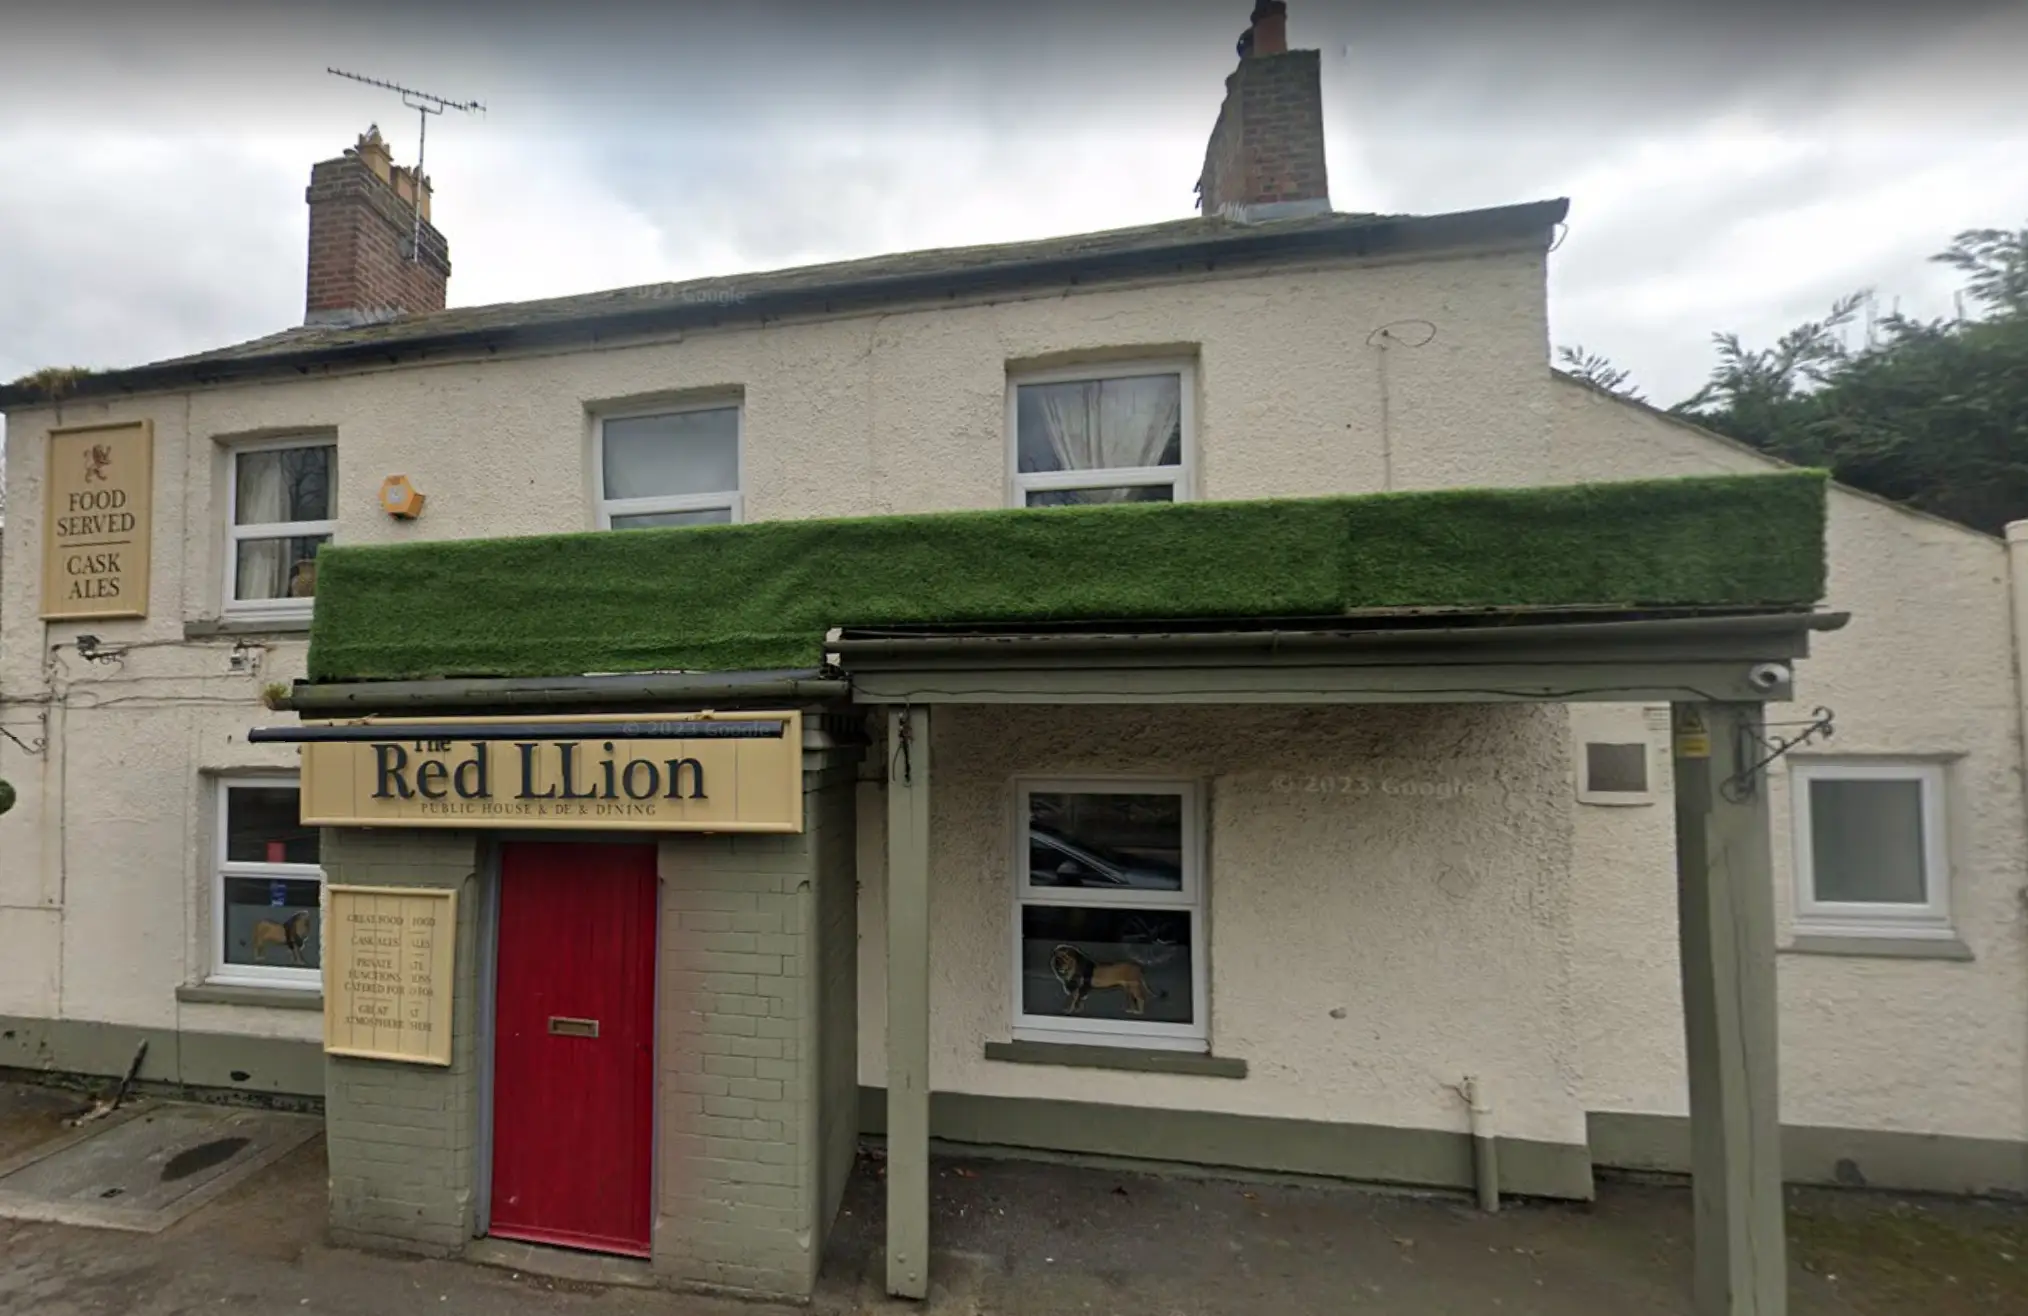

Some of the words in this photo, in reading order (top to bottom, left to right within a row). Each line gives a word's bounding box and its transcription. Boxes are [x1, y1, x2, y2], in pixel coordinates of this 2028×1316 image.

[69, 489, 126, 512] FOOD
[57, 513, 135, 537] SERVED
[66, 553, 121, 576] CASK
[68, 577, 120, 599] ALES
[371, 742, 493, 799] Red
[421, 803, 475, 814] PUBLIC
[482, 803, 532, 815] HOUSE
[538, 804, 548, 815] &
[578, 804, 589, 815] &
[596, 804, 656, 815] DINING
[378, 915, 404, 926] FOOD
[344, 982, 385, 994] CATERED
[358, 1004, 389, 1016] GREAT
